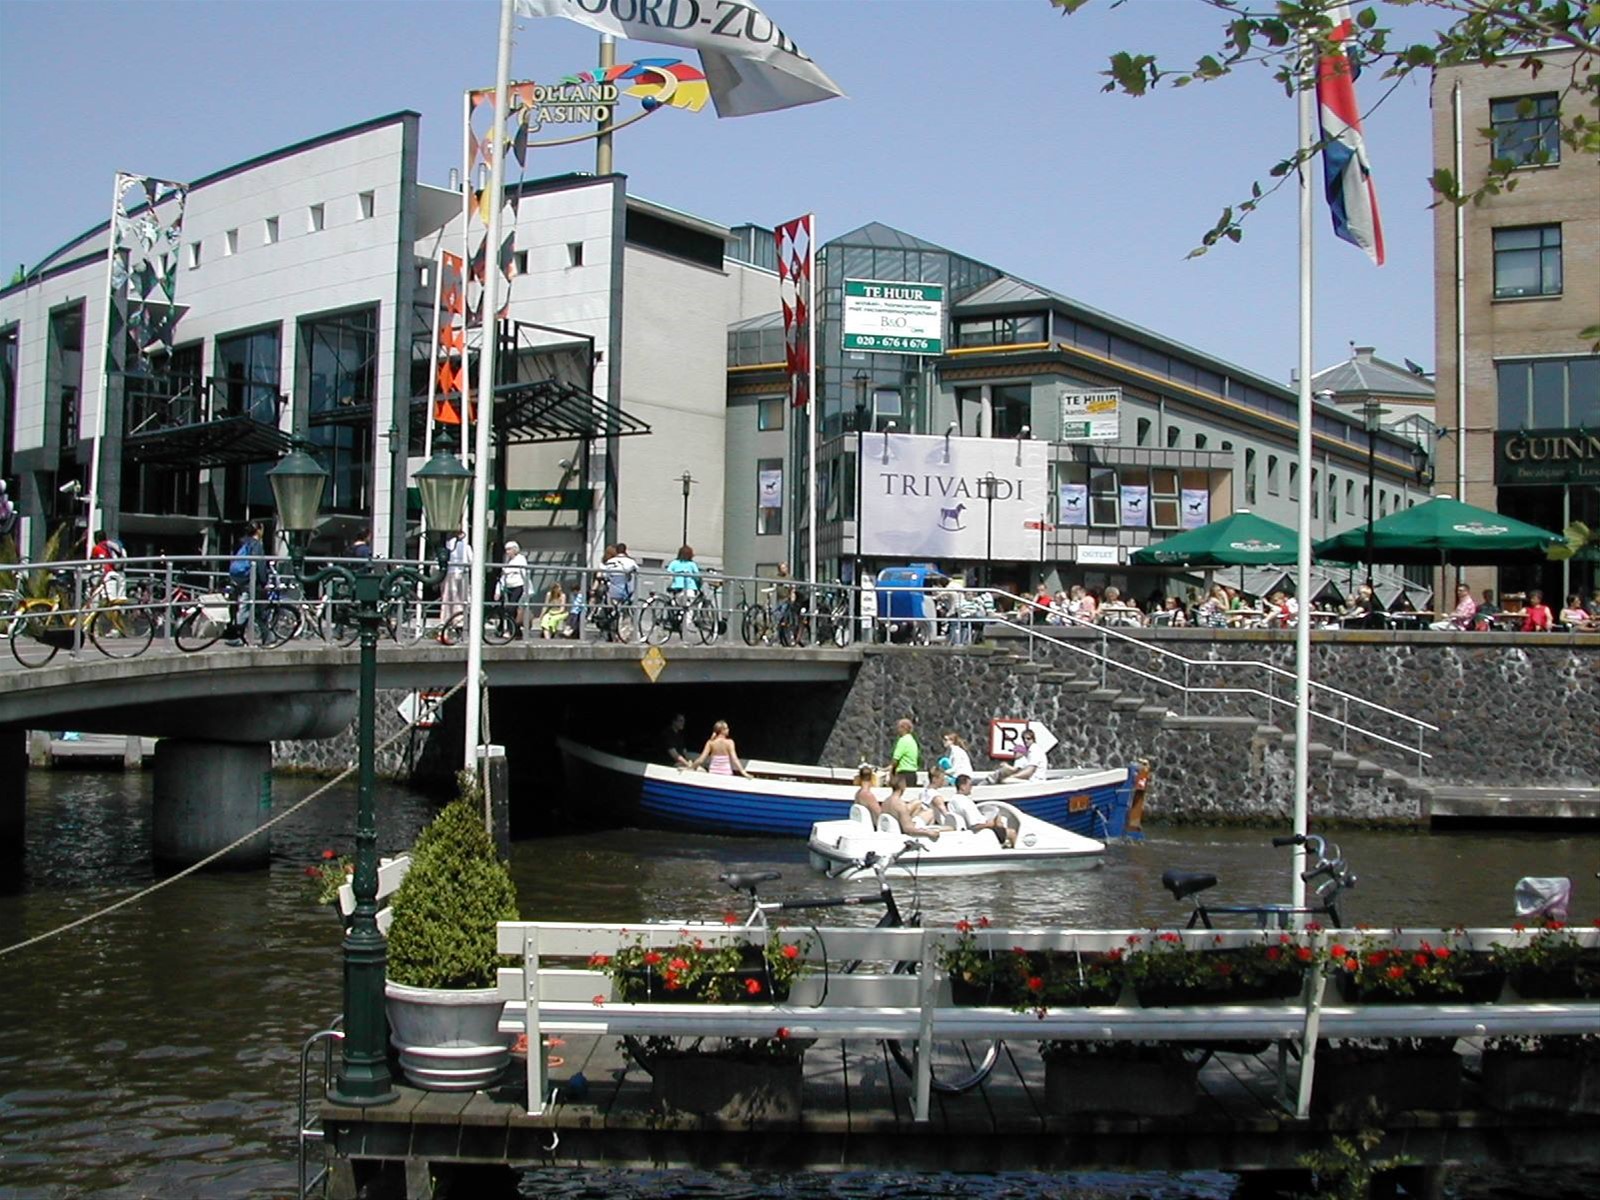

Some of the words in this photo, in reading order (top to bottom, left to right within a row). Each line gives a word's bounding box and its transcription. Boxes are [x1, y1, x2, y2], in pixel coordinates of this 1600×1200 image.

[863, 286, 881, 297] TE
[884, 287, 924, 300] HUUR
[856, 336, 875, 346] 020
[1065, 396, 1080, 405] TE
[880, 473, 1024, 501] TRIVALDI
